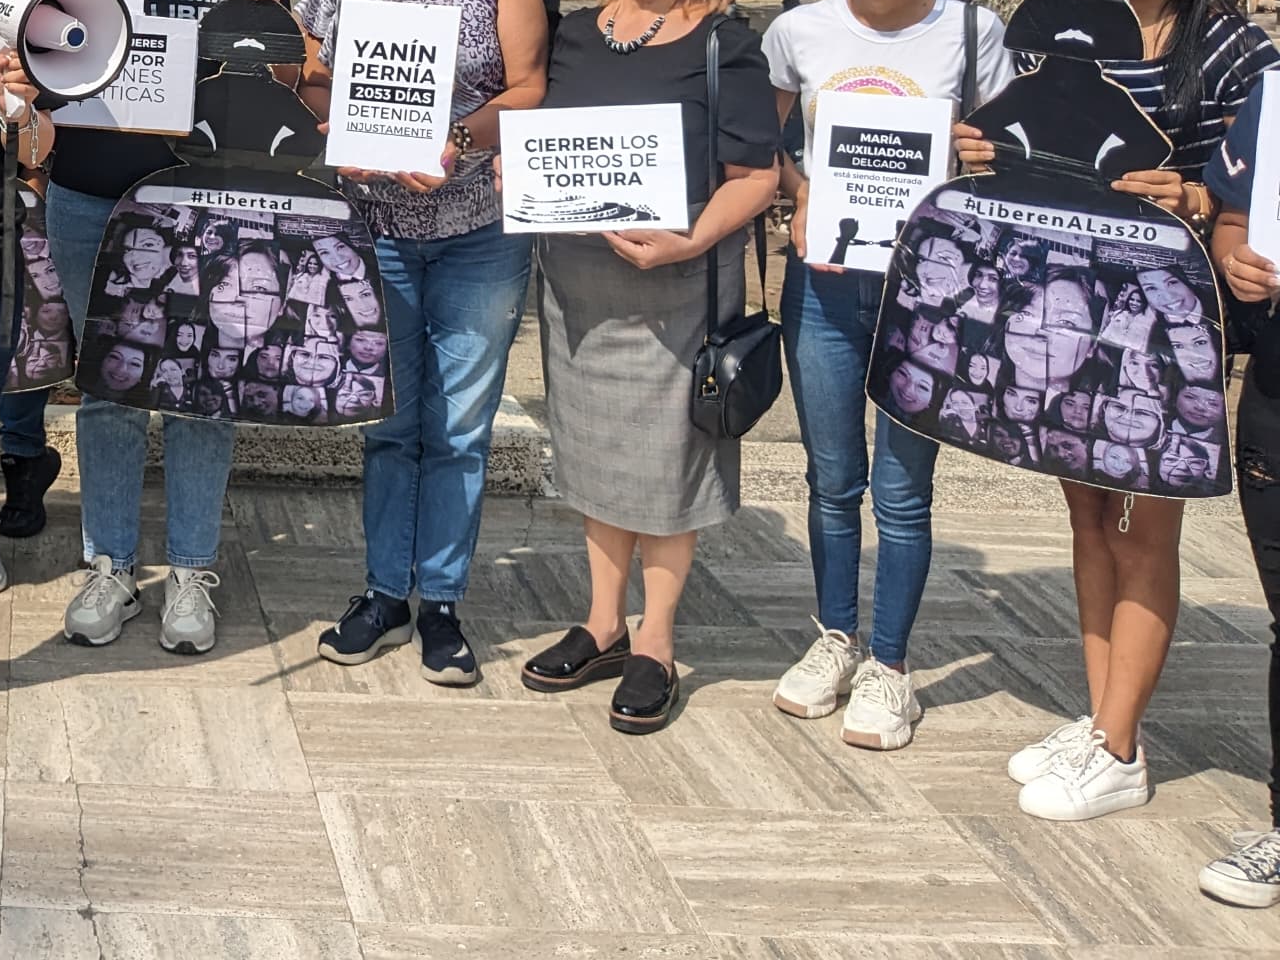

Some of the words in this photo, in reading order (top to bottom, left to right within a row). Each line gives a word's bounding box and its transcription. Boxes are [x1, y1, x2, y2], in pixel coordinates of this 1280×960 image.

[131, 54, 165, 67] POR
[353, 39, 437, 65] YANÍN
[351, 62, 436, 86] PERNÍA
[354, 86, 392, 101] 2053
[394, 87, 433, 104] DÍAS
[347, 103, 433, 125] DETENIDA
[346, 121, 433, 140] INJUSTAMENTE
[860, 132, 903, 146] MARÍA
[524, 136, 615, 154] CIERREN
[620, 134, 659, 150] LOS
[835, 143, 925, 161] AUXILIADORA
[527, 154, 623, 171] CENTROS
[629, 152, 658, 168] DE
[851, 156, 908, 171] DELGADO
[543, 171, 644, 189] TORTURA
[833, 171, 852, 180] está
[852, 172, 881, 181] siendo
[882, 175, 923, 186] torturada
[846, 182, 865, 193] EN
[867, 184, 911, 198] DGCIM
[191, 190, 293, 211] #Libertad
[849, 194, 906, 210] BOLEÍTA
[964, 196, 1158, 242] #LiberenALas20
